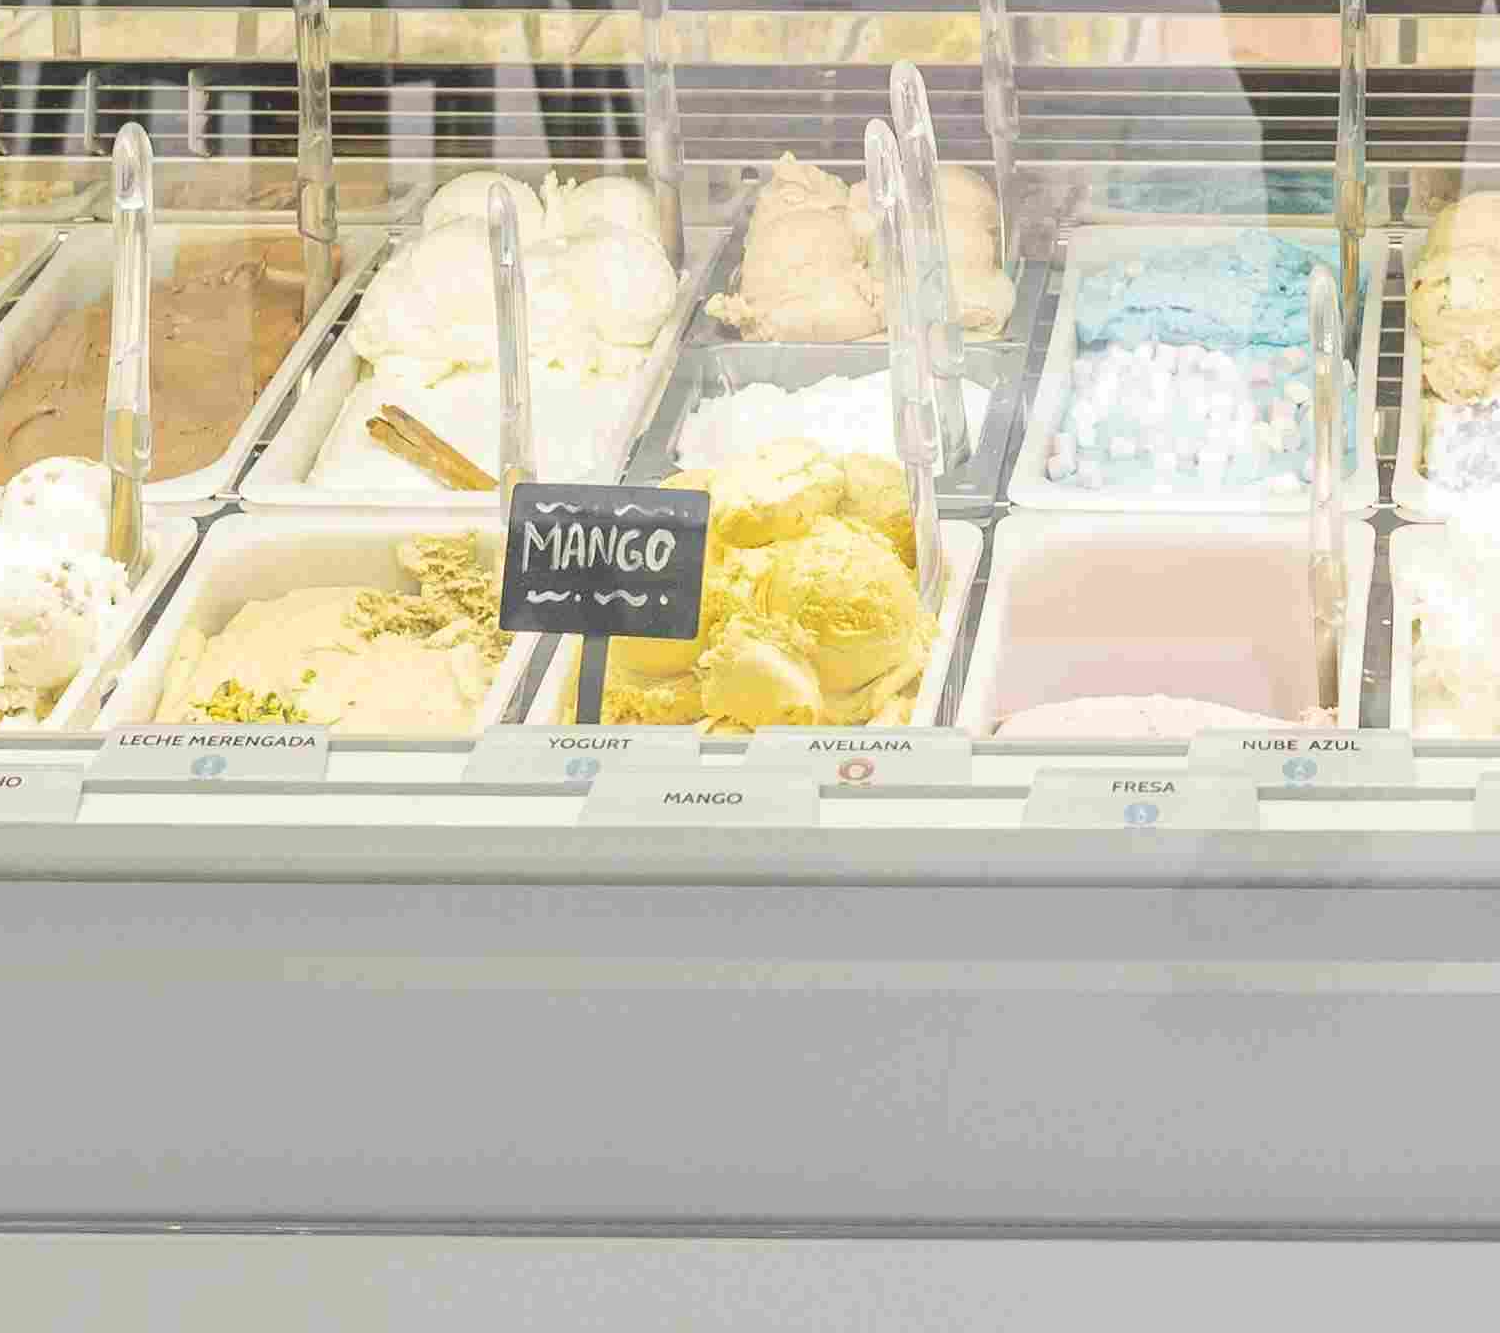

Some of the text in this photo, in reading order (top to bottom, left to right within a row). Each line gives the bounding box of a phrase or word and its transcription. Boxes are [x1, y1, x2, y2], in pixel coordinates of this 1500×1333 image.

[521, 519, 677, 574] MANGO
[118, 734, 317, 749] LECHE MERENGADA
[548, 737, 635, 750] YOGURT
[808, 739, 914, 752] AVELLANA
[1241, 739, 1363, 753] NUBE AZUL
[1111, 780, 1177, 794] FRESA
[662, 791, 744, 806] MANGO
